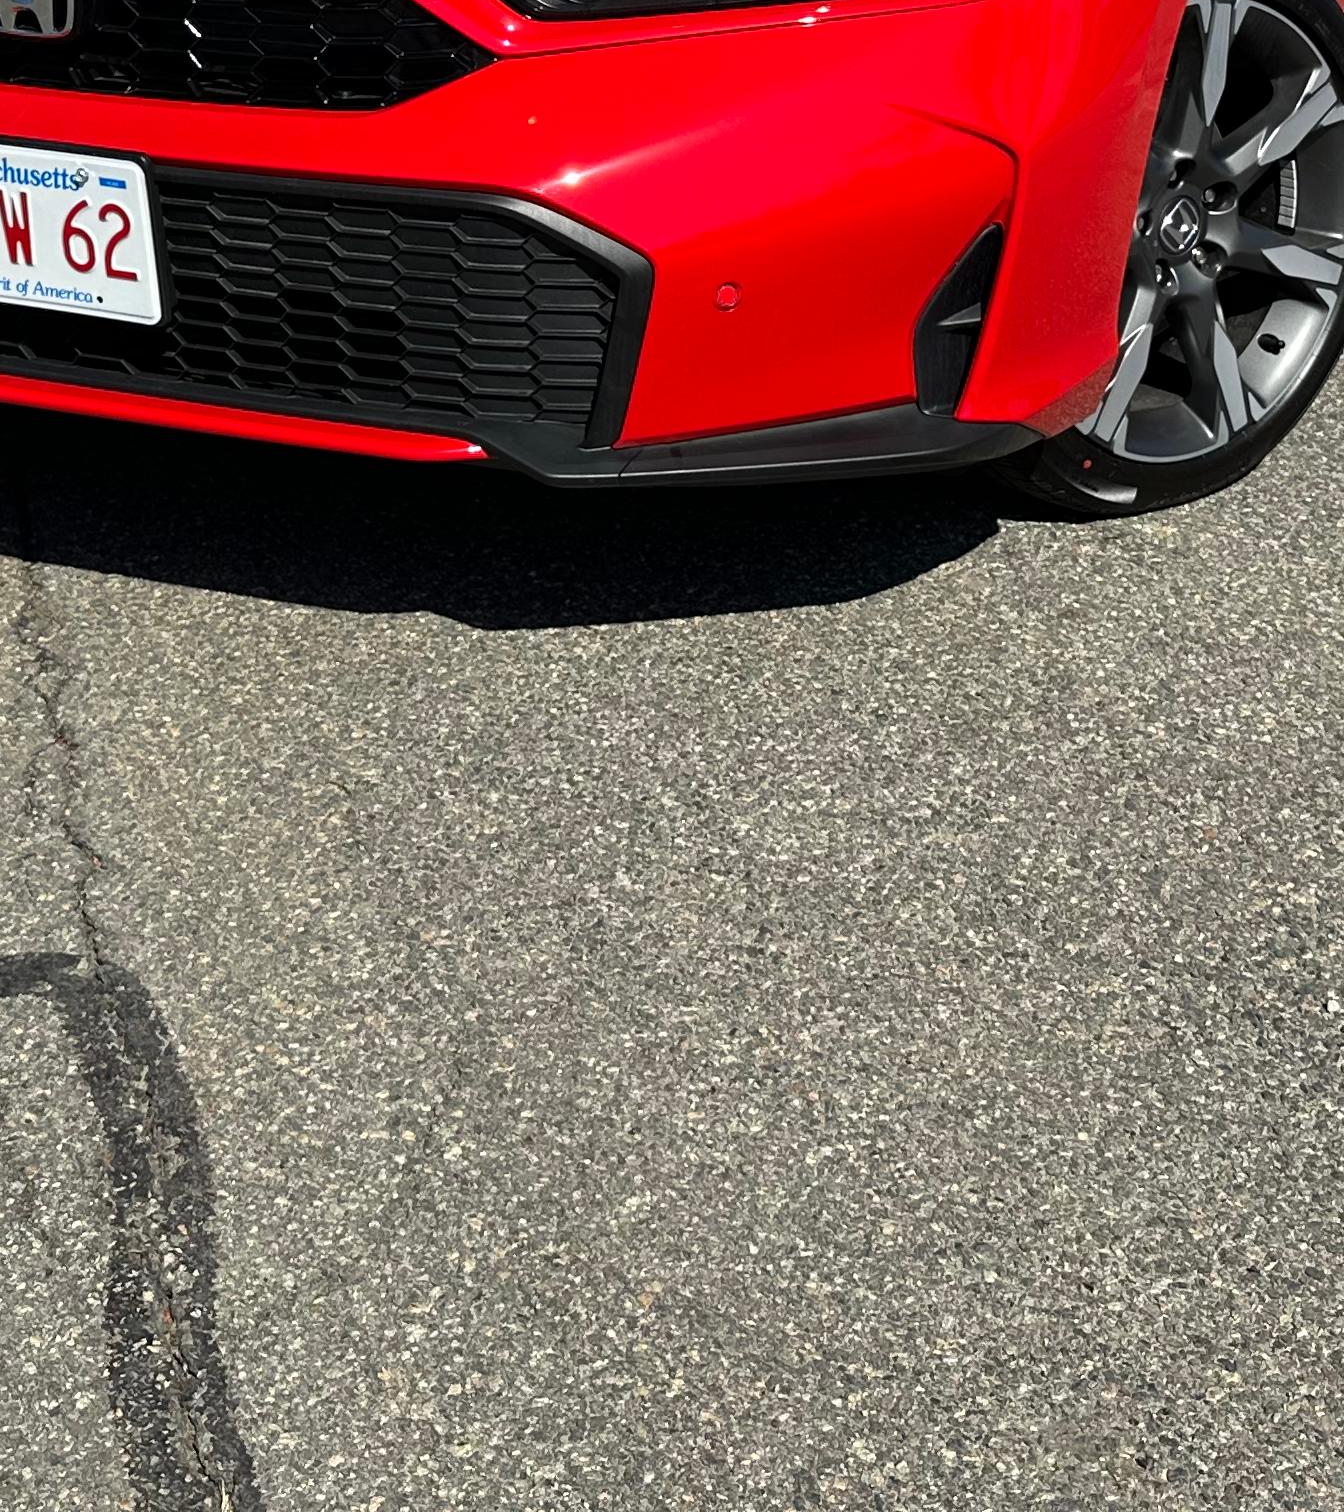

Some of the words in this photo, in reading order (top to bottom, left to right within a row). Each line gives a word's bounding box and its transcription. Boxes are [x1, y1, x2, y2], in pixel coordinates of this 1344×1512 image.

[62, 199, 138, 282] 62
[16, 278, 30, 297] of
[33, 282, 93, 304] America
